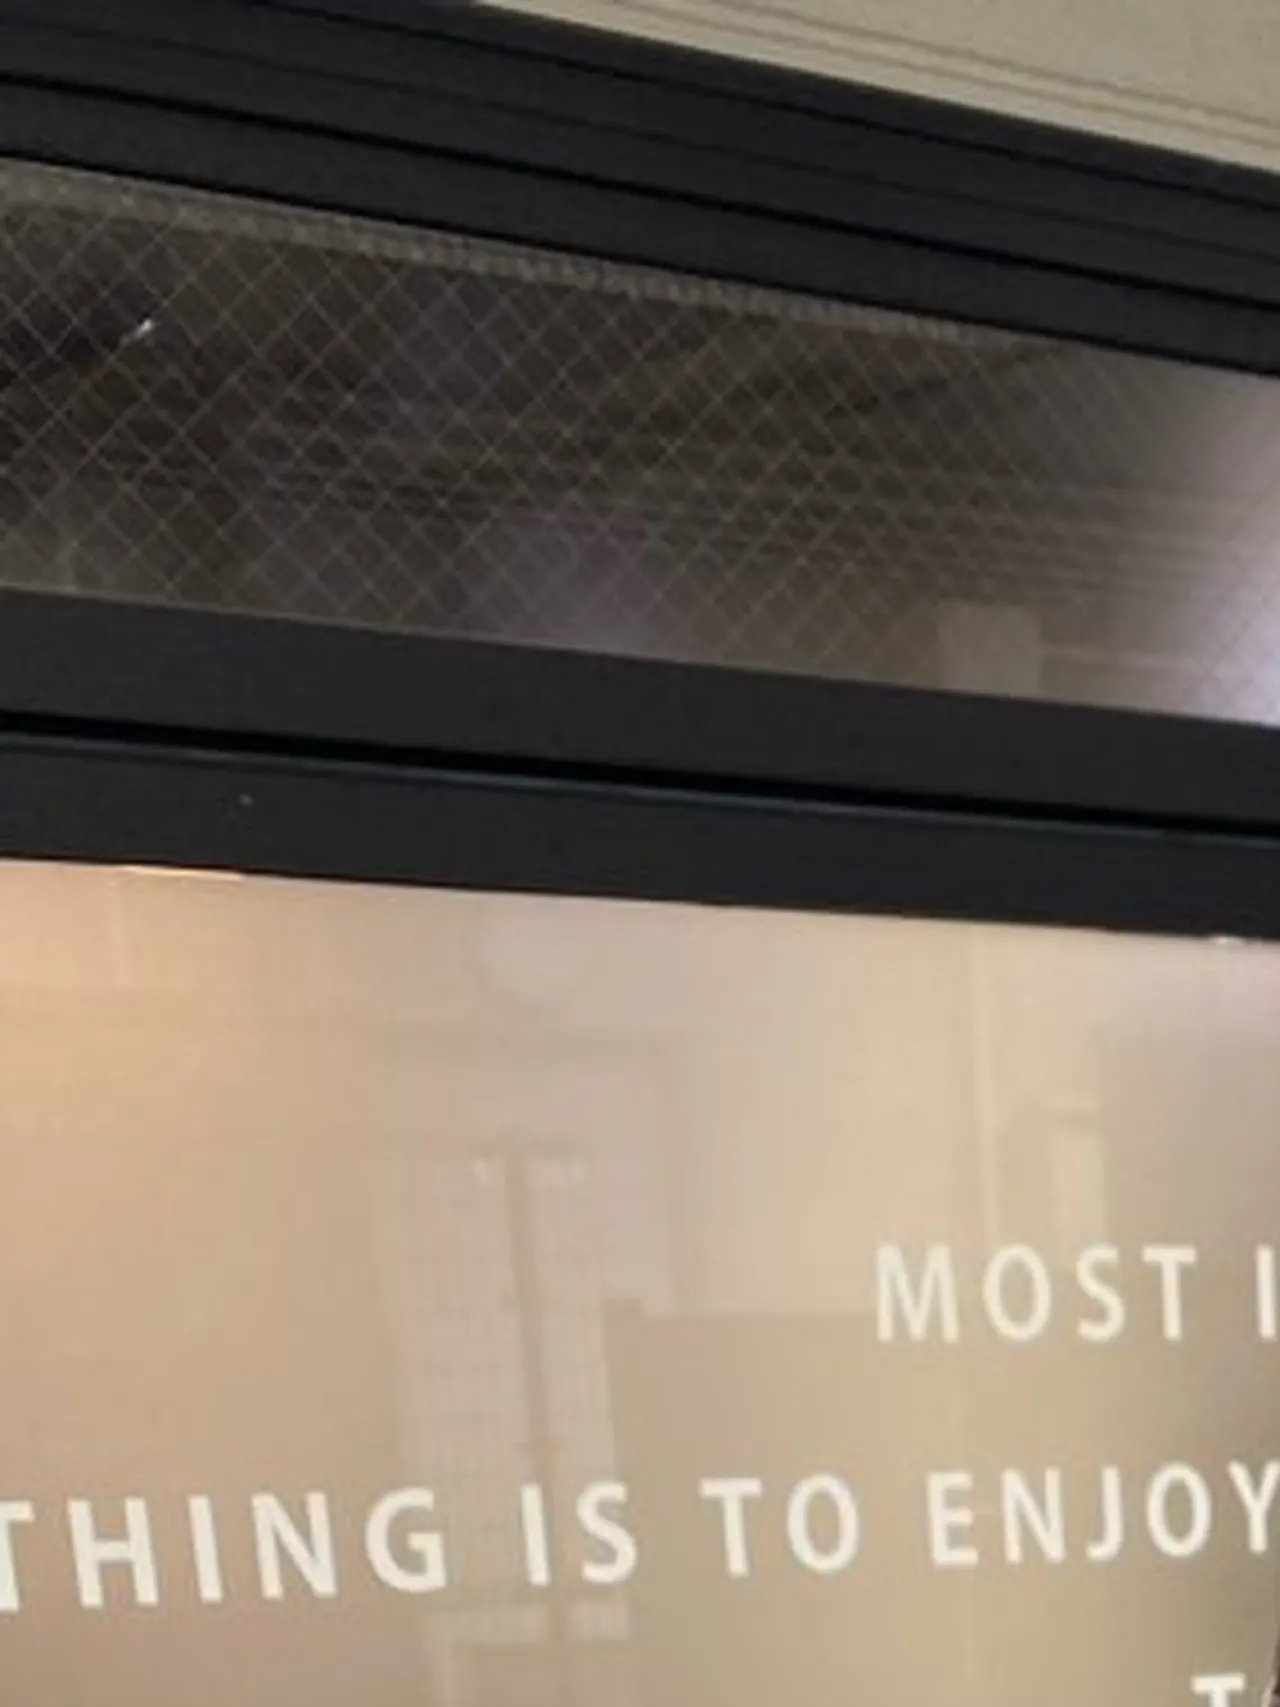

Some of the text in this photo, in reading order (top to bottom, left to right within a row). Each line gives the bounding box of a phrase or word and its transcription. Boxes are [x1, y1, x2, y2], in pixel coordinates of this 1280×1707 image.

[873, 1243, 1197, 1342] MOST
[0, 1486, 447, 1612] THING
[520, 1481, 638, 1587] IS
[699, 1473, 861, 1578] TO
